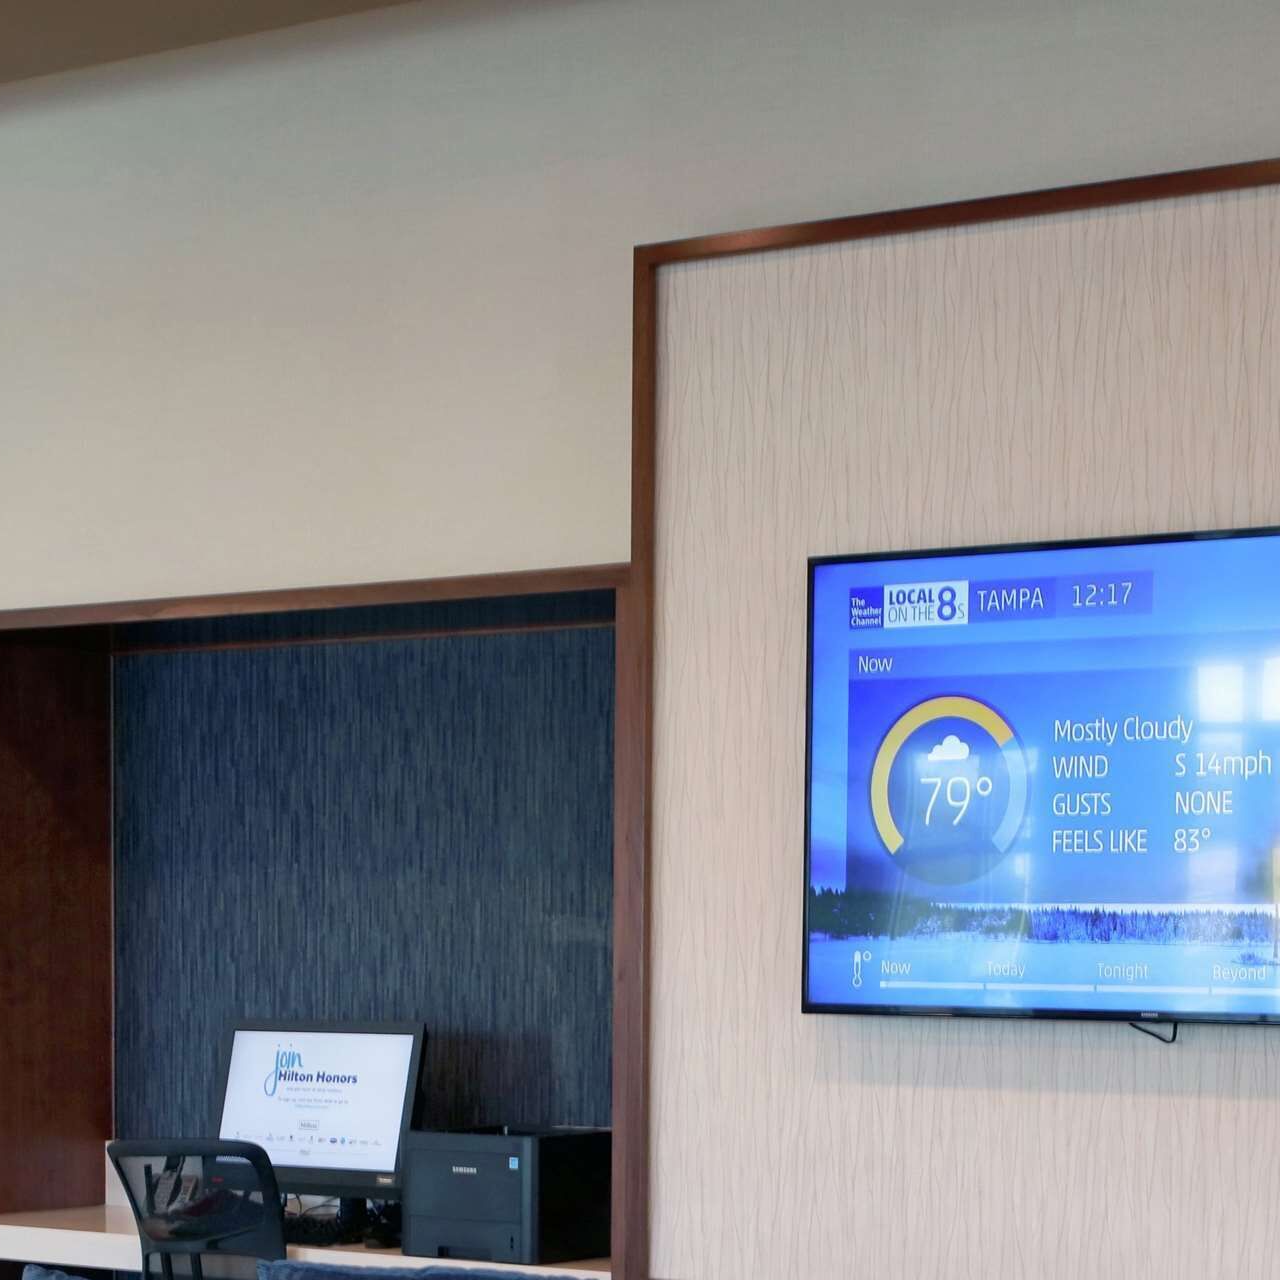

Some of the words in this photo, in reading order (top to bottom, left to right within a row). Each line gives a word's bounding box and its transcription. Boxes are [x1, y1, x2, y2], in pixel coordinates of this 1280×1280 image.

[851, 597, 865, 607] The
[889, 588, 935, 605] LOCAL
[977, 587, 1044, 612] TAMPA
[1072, 582, 1133, 607] 12:17
[851, 607, 882, 616] Weather
[851, 616, 881, 626] Channel
[888, 606, 907, 623] ON
[911, 604, 934, 622] THE
[858, 655, 893, 673] Now
[1054, 717, 1118, 747] Mostly
[1123, 714, 1193, 744] Cloudy
[1052, 755, 1109, 778] WIND
[1175, 752, 1186, 776] S
[1195, 750, 1272, 780] 14mph
[1052, 792, 1112, 815] GUSTS
[1175, 790, 1233, 814] NONE
[1052, 829, 1104, 853] FEELS
[1110, 829, 1148, 852] LIKE
[1173, 827, 1212, 852] 83°
[880, 960, 911, 976] Now
[986, 961, 1026, 979] Today
[1096, 962, 1149, 980] Tonight
[1211, 965, 1267, 982] Beyond
[264, 1043, 304, 1096] join
[278, 1070, 313, 1083] Hilton
[316, 1071, 358, 1084] Honors
